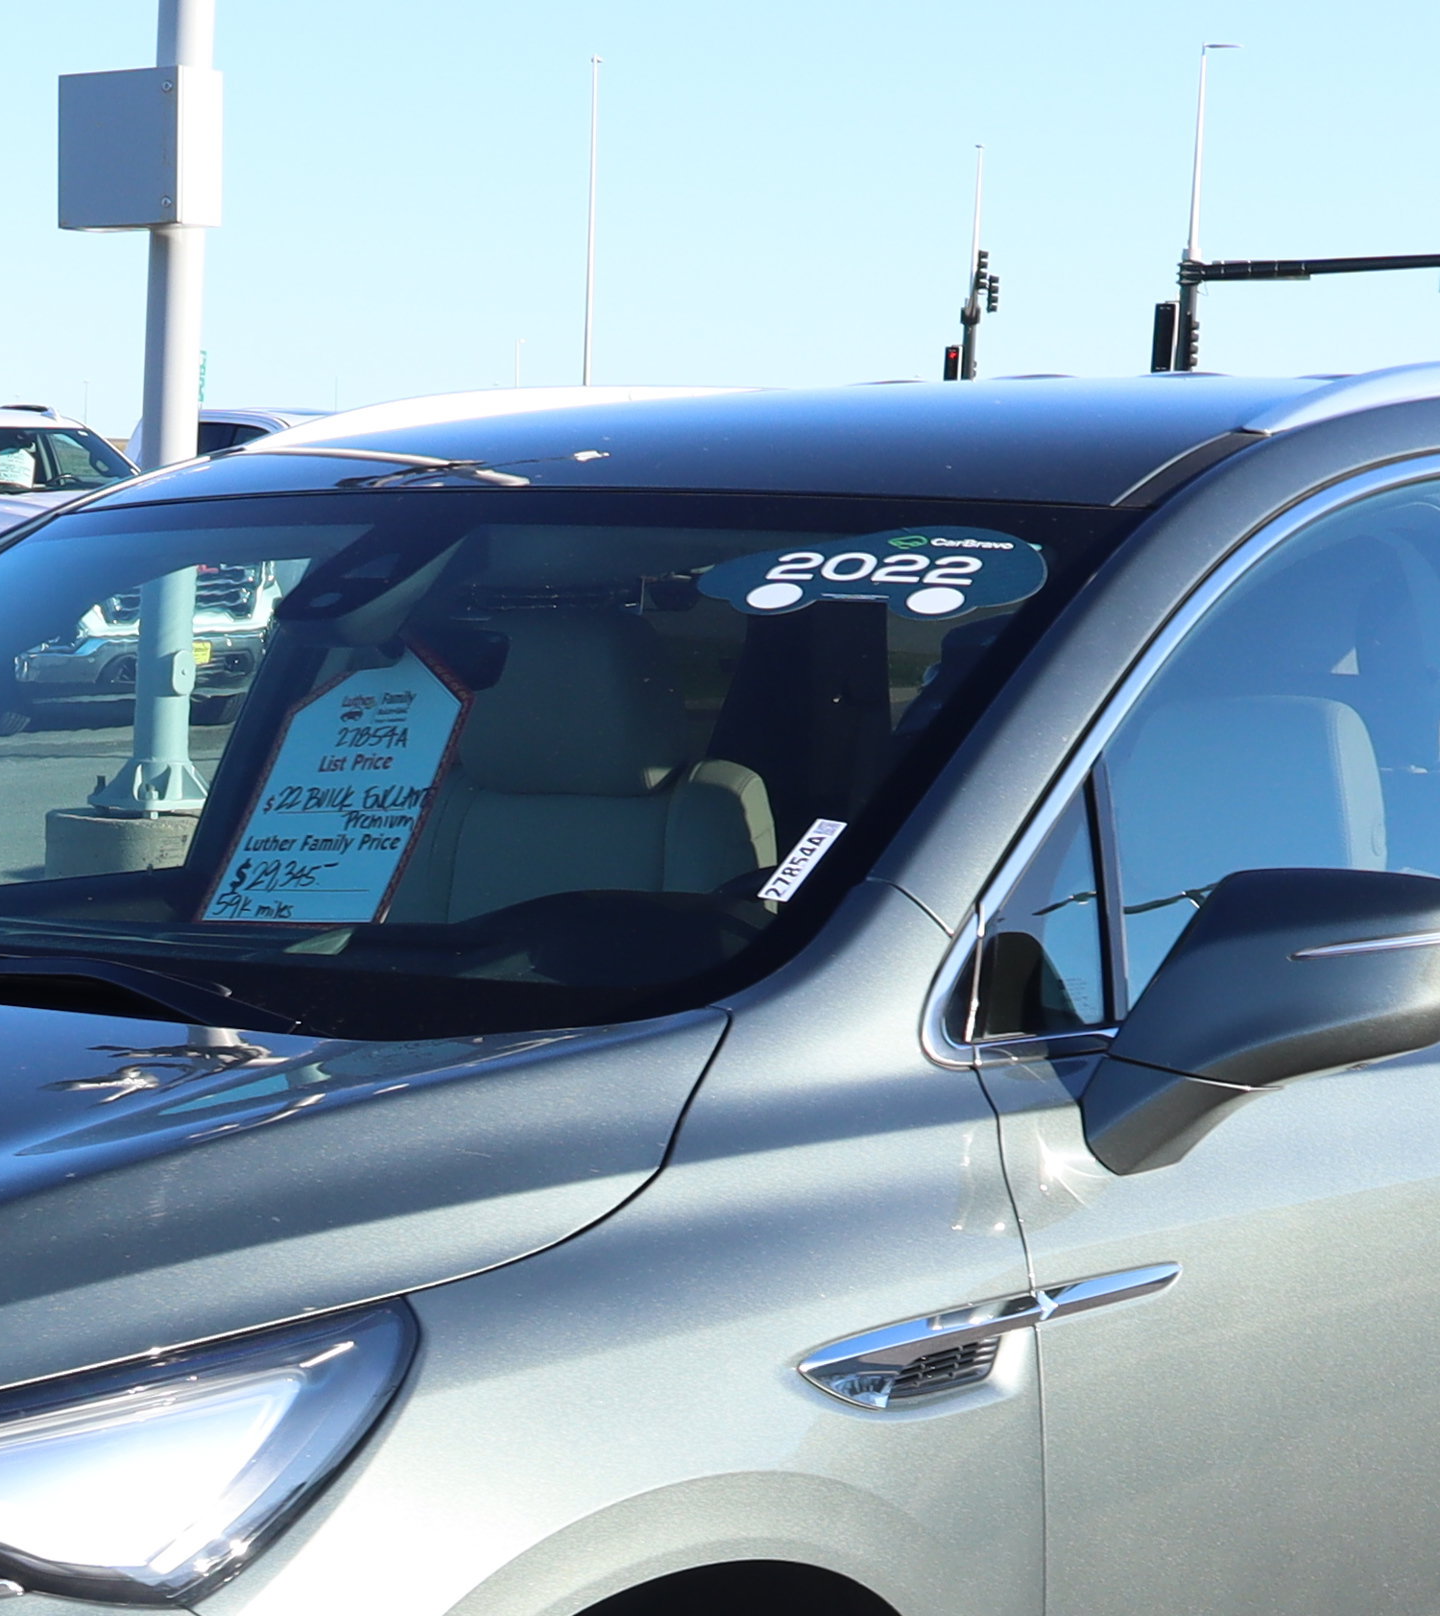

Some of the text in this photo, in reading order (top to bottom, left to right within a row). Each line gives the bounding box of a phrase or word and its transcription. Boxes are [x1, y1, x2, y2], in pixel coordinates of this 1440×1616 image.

[930, 537, 1014, 550] CarBravo
[765, 552, 983, 586] 2022
[335, 726, 409, 749] 27854A
[318, 753, 394, 772] List Price
[244, 832, 401, 855] Luther Family Price
